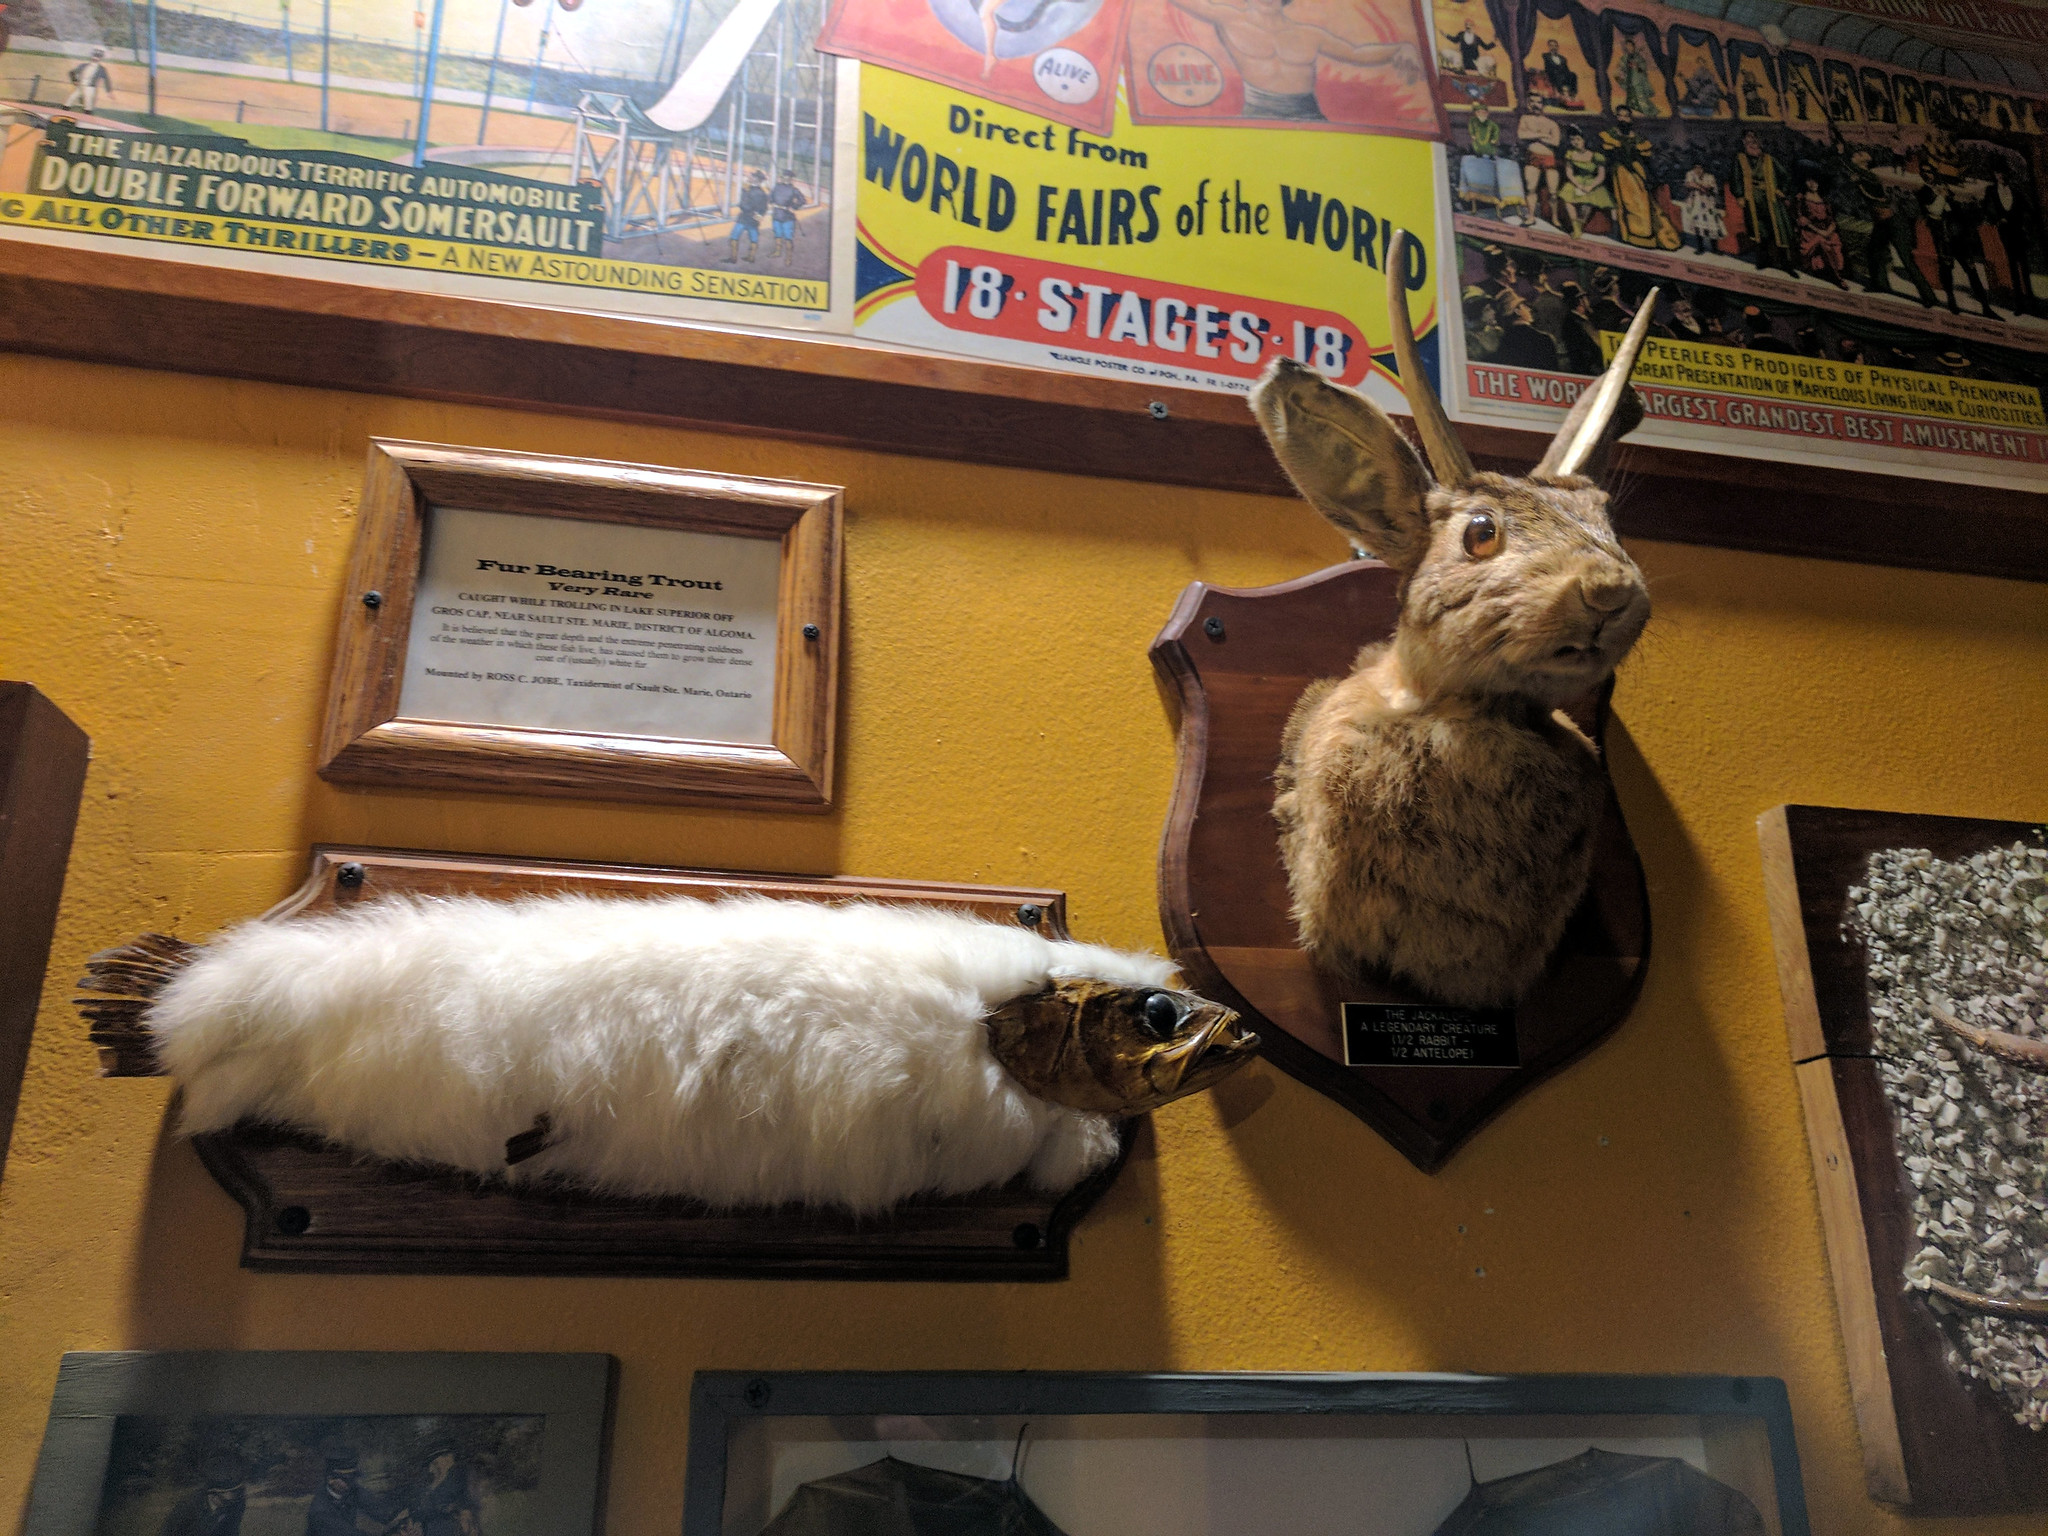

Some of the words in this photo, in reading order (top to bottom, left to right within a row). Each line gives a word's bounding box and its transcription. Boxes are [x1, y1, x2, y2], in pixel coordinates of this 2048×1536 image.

[1038, 57, 1091, 84] ALIVE
[1154, 63, 1219, 85] ALIVE
[949, 104, 1056, 151] Direct
[1067, 126, 1149, 169] from
[67, 131, 122, 160] THE
[298, 161, 415, 194] TERRIFIC
[421, 178, 583, 213] AUTOMOBILE
[862, 111, 1016, 233] WORLD
[1036, 185, 1161, 246] FAIRS
[1176, 179, 1211, 237] of
[1219, 180, 1270, 236] the
[40, 155, 190, 208] DOUBLE
[195, 174, 374, 228] FORWARD
[378, 195, 595, 253] SOMERSAULT
[31, 201, 92, 226] ALL
[100, 207, 215, 241] OTHER
[441, 246, 461, 267] A
[467, 248, 521, 273] NEW
[531, 255, 683, 291] ASTOUNDING
[690, 271, 819, 306] SENSATION
[943, 260, 1014, 320] 18
[1037, 277, 1270, 364] STAGES
[1293, 320, 1353, 378] 18
[1095, 358, 1129, 372] POSTER
[1645, 340, 1736, 369] PEERLESS
[1742, 353, 1838, 382] PRODIGIES
[1844, 369, 1864, 384] OF
[1870, 369, 1946, 396] PHYSICAL
[1949, 380, 2038, 407] PHENOMENA
[1634, 361, 1675, 380] GREAT
[1676, 363, 1774, 392] PRESENTATION
[1776, 379, 1790, 394] OF
[1793, 378, 1867, 404] MARVELOUS
[1867, 388, 1908, 409] LIVING
[1909, 393, 1954, 414] HUMAN
[1474, 370, 1521, 398] THE
[1844, 415, 1893, 442] BEST
[1902, 423, 2029, 458] AMUSEMENT
[476, 559, 531, 574] Fur
[535, 564, 644, 587] Bearing
[648, 574, 724, 591] Trout
[547, 581, 600, 598] Very
[602, 586, 655, 600] Rare
[431, 606, 464, 617] GROS
[494, 611, 526, 622] NEAR
[528, 613, 565, 625] SAULT
[634, 622, 685, 634] DISTRICT
[687, 626, 702, 635] OF
[458, 592, 506, 603] CAUGHT
[509, 596, 548, 607] WHILE
[550, 599, 607, 612] TROLLING
[610, 604, 621, 612] IN
[624, 605, 656, 616] LAKE
[656, 608, 711, 620] SUPERIOR
[713, 613, 735, 623] OFF
[429, 633, 441, 642] of
[506, 640, 534, 650] which
[451, 624, 459, 633] is
[462, 624, 498, 636] believed
[501, 627, 518, 637] that
[519, 629, 535, 639] the
[536, 631, 559, 641] great
[560, 632, 585, 643] depth
[621, 638, 656, 648] extreme
[657, 641, 706, 654] penetrating
[424, 667, 470, 680] Mounted
[471, 671, 483, 682] by
[486, 672, 516, 683] ROSS
[517, 674, 529, 684] C.
[566, 677, 622, 691] Taxidermist
[624, 681, 635, 691] of
[636, 683, 661, 694] Sault
[715, 688, 753, 700] Ontario
[1360, 1021, 1369, 1032] A
[1372, 1021, 1436, 1034] LEGENDARY
[1442, 1023, 1499, 1035] CREATURE
[1385, 1009, 1406, 1020] THE
[1418, 1035, 1458, 1047] RABBIT
